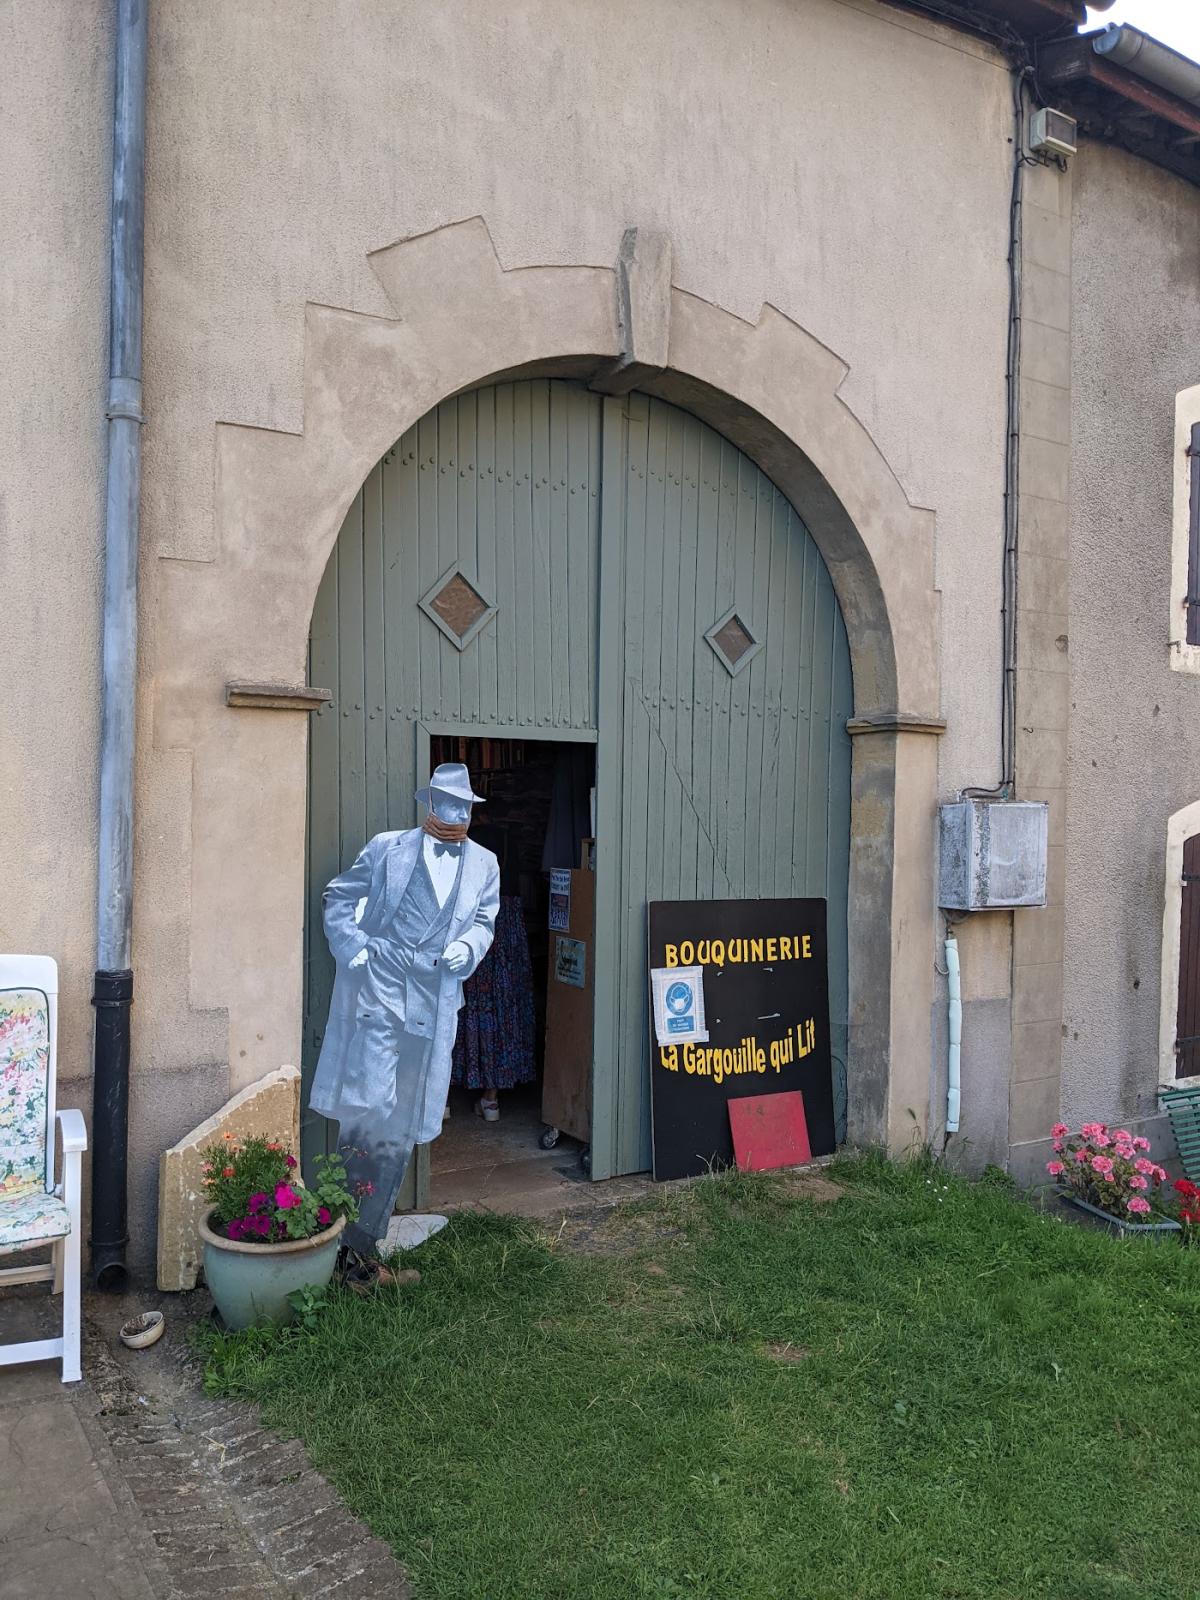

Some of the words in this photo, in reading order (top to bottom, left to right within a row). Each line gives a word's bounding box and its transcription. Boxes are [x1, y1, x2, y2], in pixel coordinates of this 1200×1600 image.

[665, 934, 813, 969] BOUQUINERIE
[682, 1036, 767, 1085] Gargouille
[769, 1028, 794, 1075] qui
[796, 1017, 816, 1059] Lit
